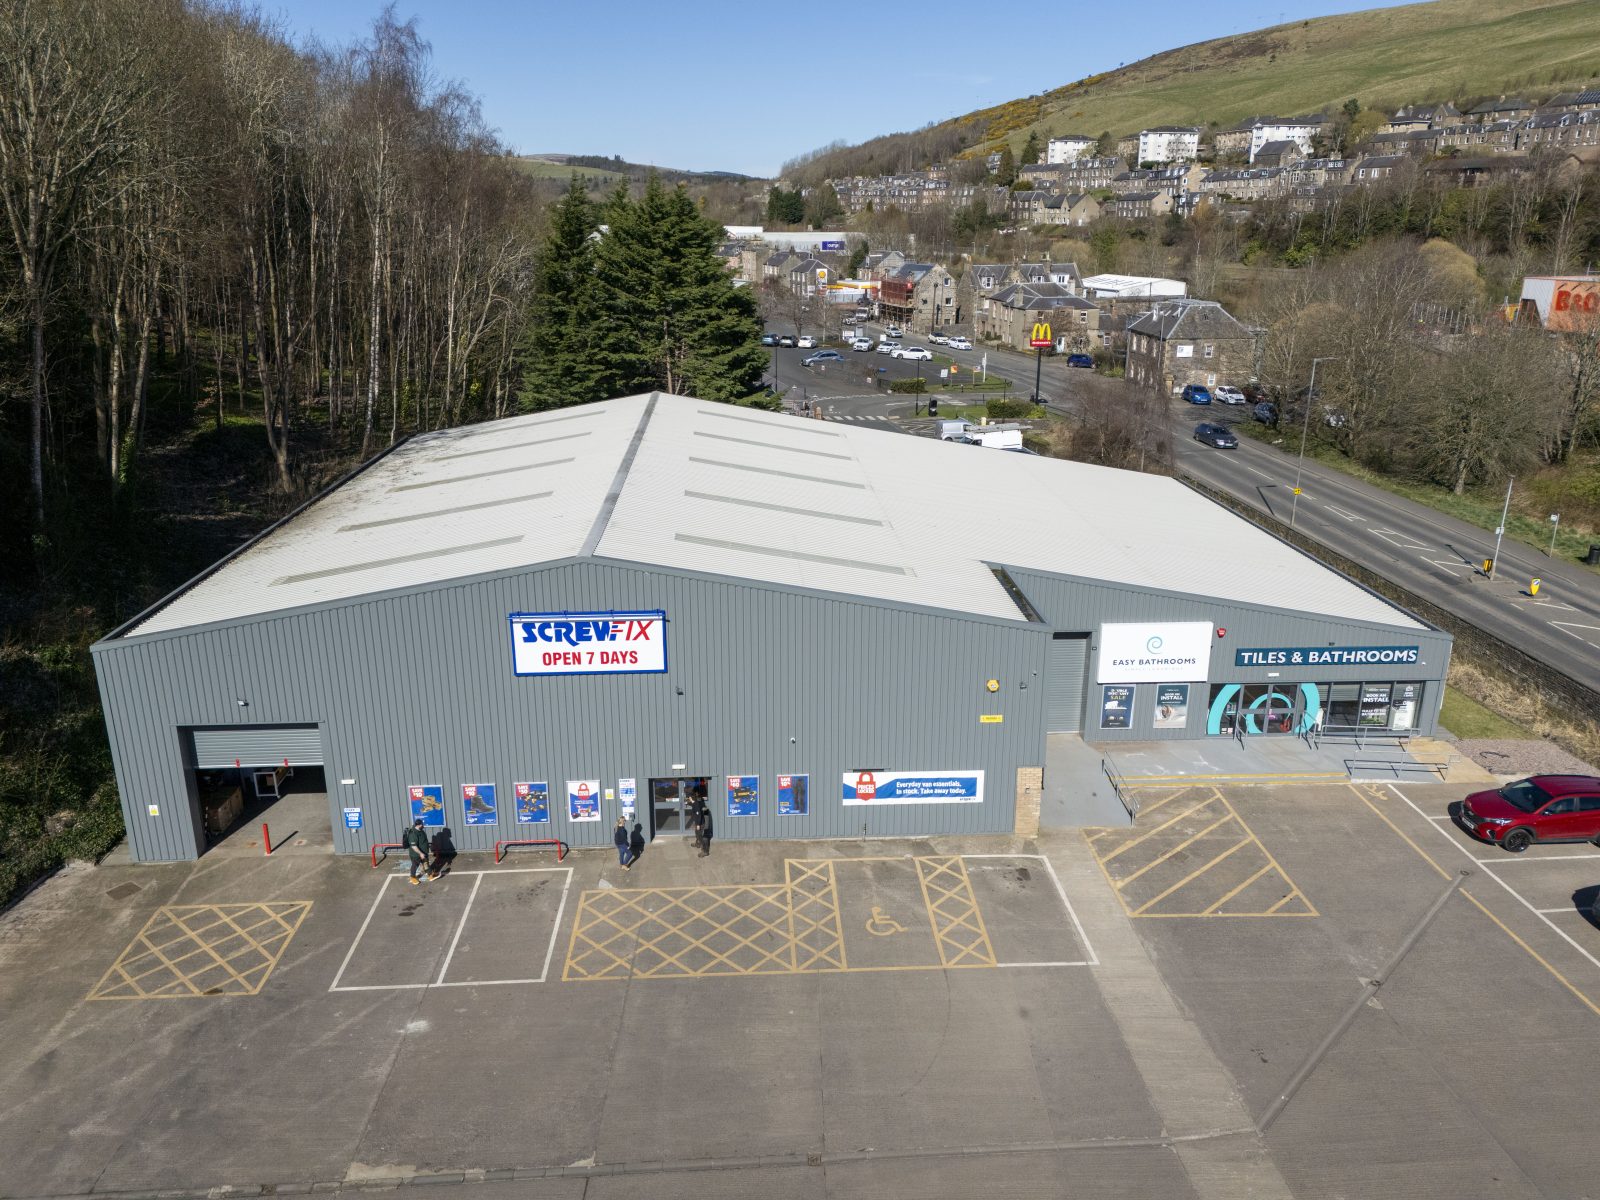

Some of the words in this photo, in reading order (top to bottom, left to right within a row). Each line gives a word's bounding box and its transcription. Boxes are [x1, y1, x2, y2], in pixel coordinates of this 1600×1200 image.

[522, 620, 654, 647] SCREWFIX
[542, 651, 582, 666] OPEN
[586, 651, 595, 665] 7
[600, 650, 638, 665] DAYS
[1138, 658, 1196, 666] BATHROOMS
[1241, 651, 1286, 664] TILES
[1291, 651, 1302, 663] &
[1308, 649, 1417, 663] BATHROOMS
[896, 781, 921, 790] Everyday
[932, 780, 962, 788] essentials.
[934, 788, 949, 796] away
[949, 787, 967, 796] today.
